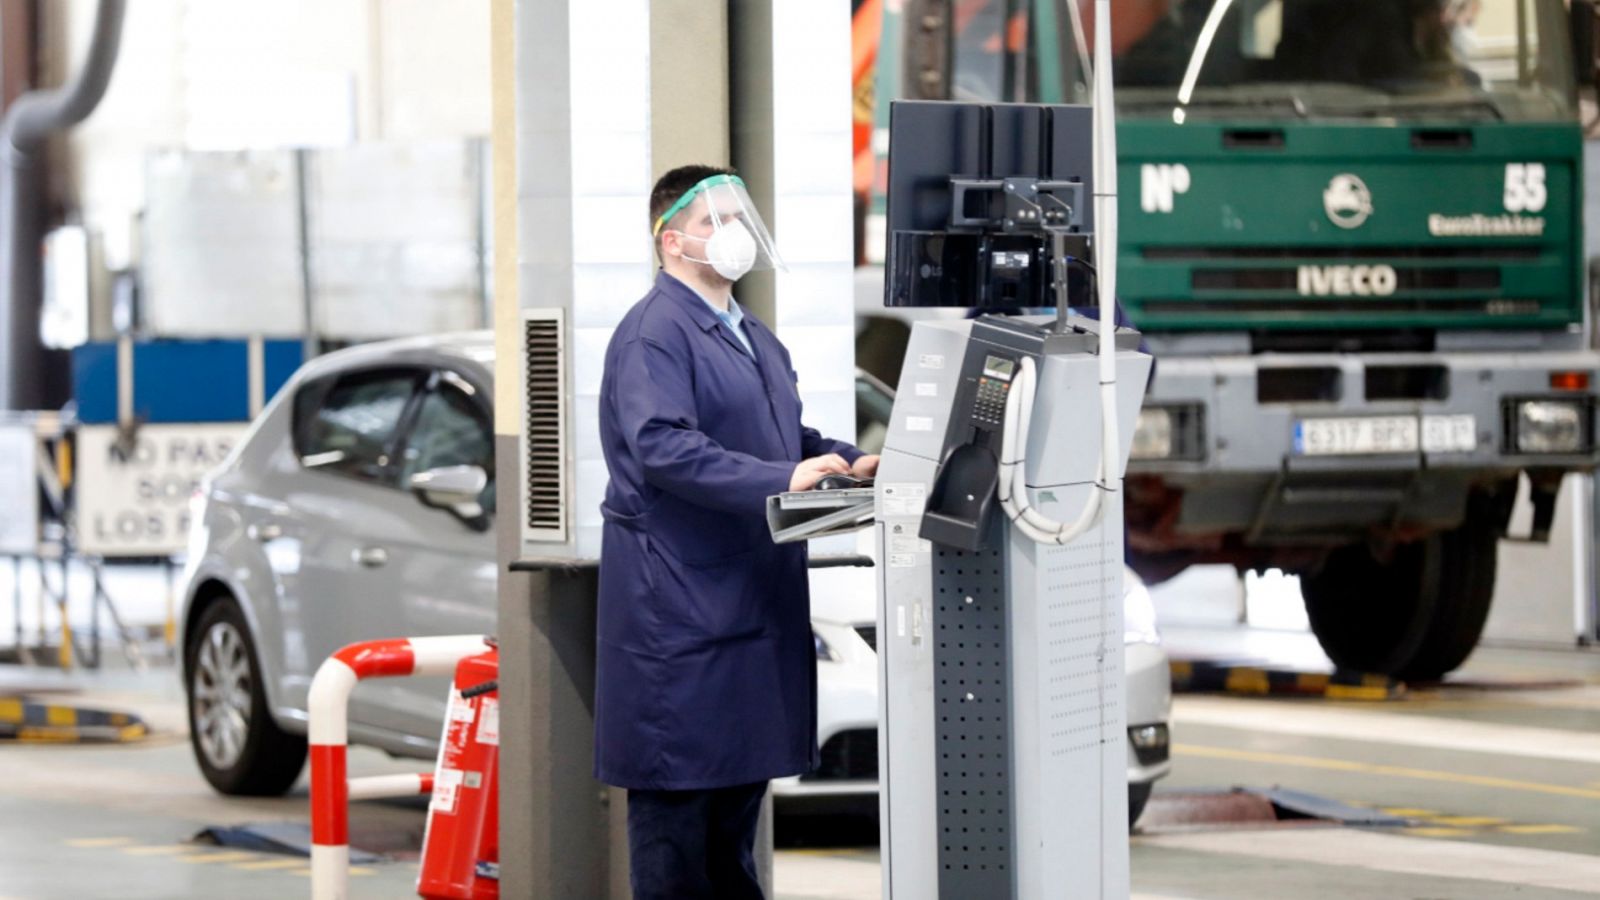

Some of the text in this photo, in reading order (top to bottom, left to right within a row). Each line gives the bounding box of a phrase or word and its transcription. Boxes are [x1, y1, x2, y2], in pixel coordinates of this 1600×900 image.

[1503, 162, 1547, 213] 55
[1298, 264, 1397, 296] IVECO
[94, 512, 167, 541] LOS
